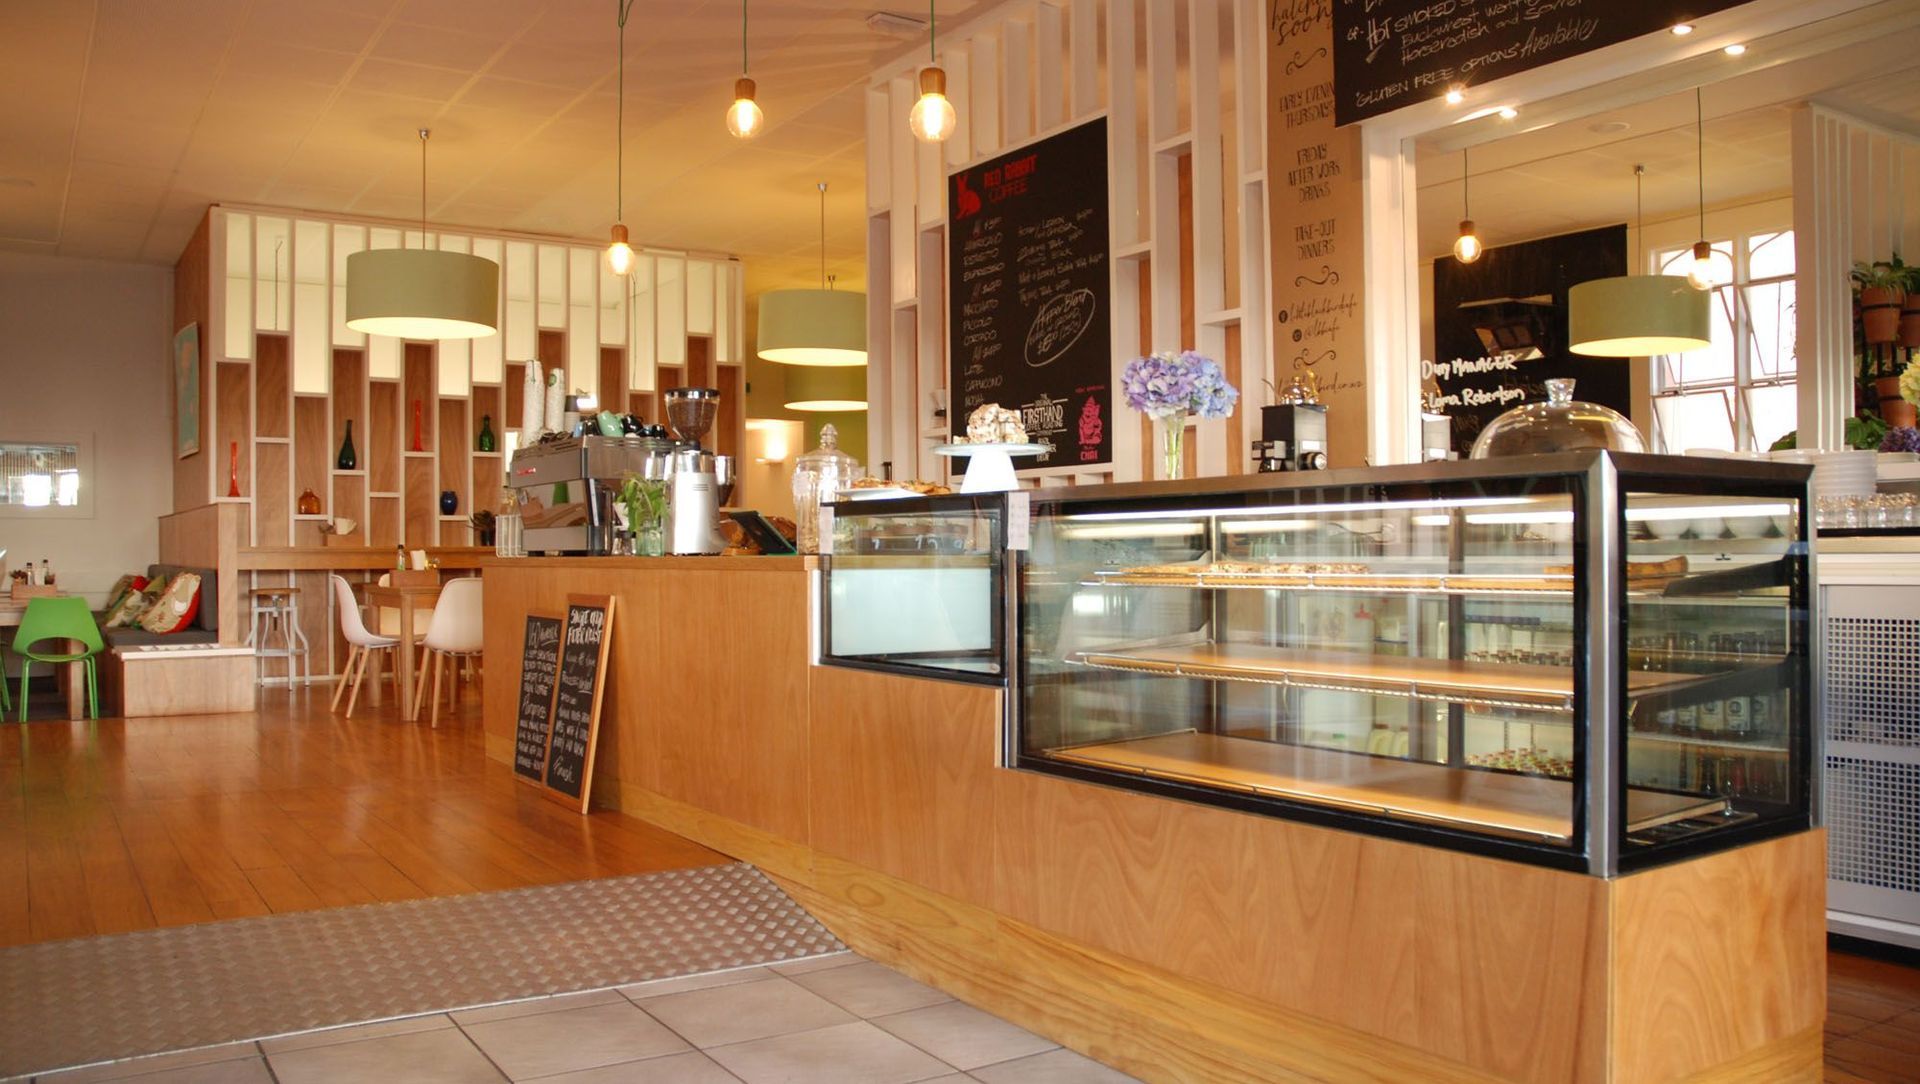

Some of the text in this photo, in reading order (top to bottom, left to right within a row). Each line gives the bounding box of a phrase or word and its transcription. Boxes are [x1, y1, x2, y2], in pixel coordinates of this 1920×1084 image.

[1277, 6, 1332, 46] soon
[1394, 0, 1457, 32] SMOKED
[1414, 67, 1454, 89] FREE
[1520, 17, 1599, 58] Available
[1305, 82, 1335, 104] EVENIN
[1297, 143, 1328, 166] FRIDAY
[1288, 160, 1342, 188] AFTER WORK
[1300, 181, 1332, 203] DRINKS
[1294, 218, 1337, 243] TAKE-OUT
[1297, 239, 1336, 261] DINNERS
[1451, 354, 1517, 377] MANAGER
[1462, 385, 1526, 406] Robertson
[1022, 404, 1064, 427] FIRSTHAND
